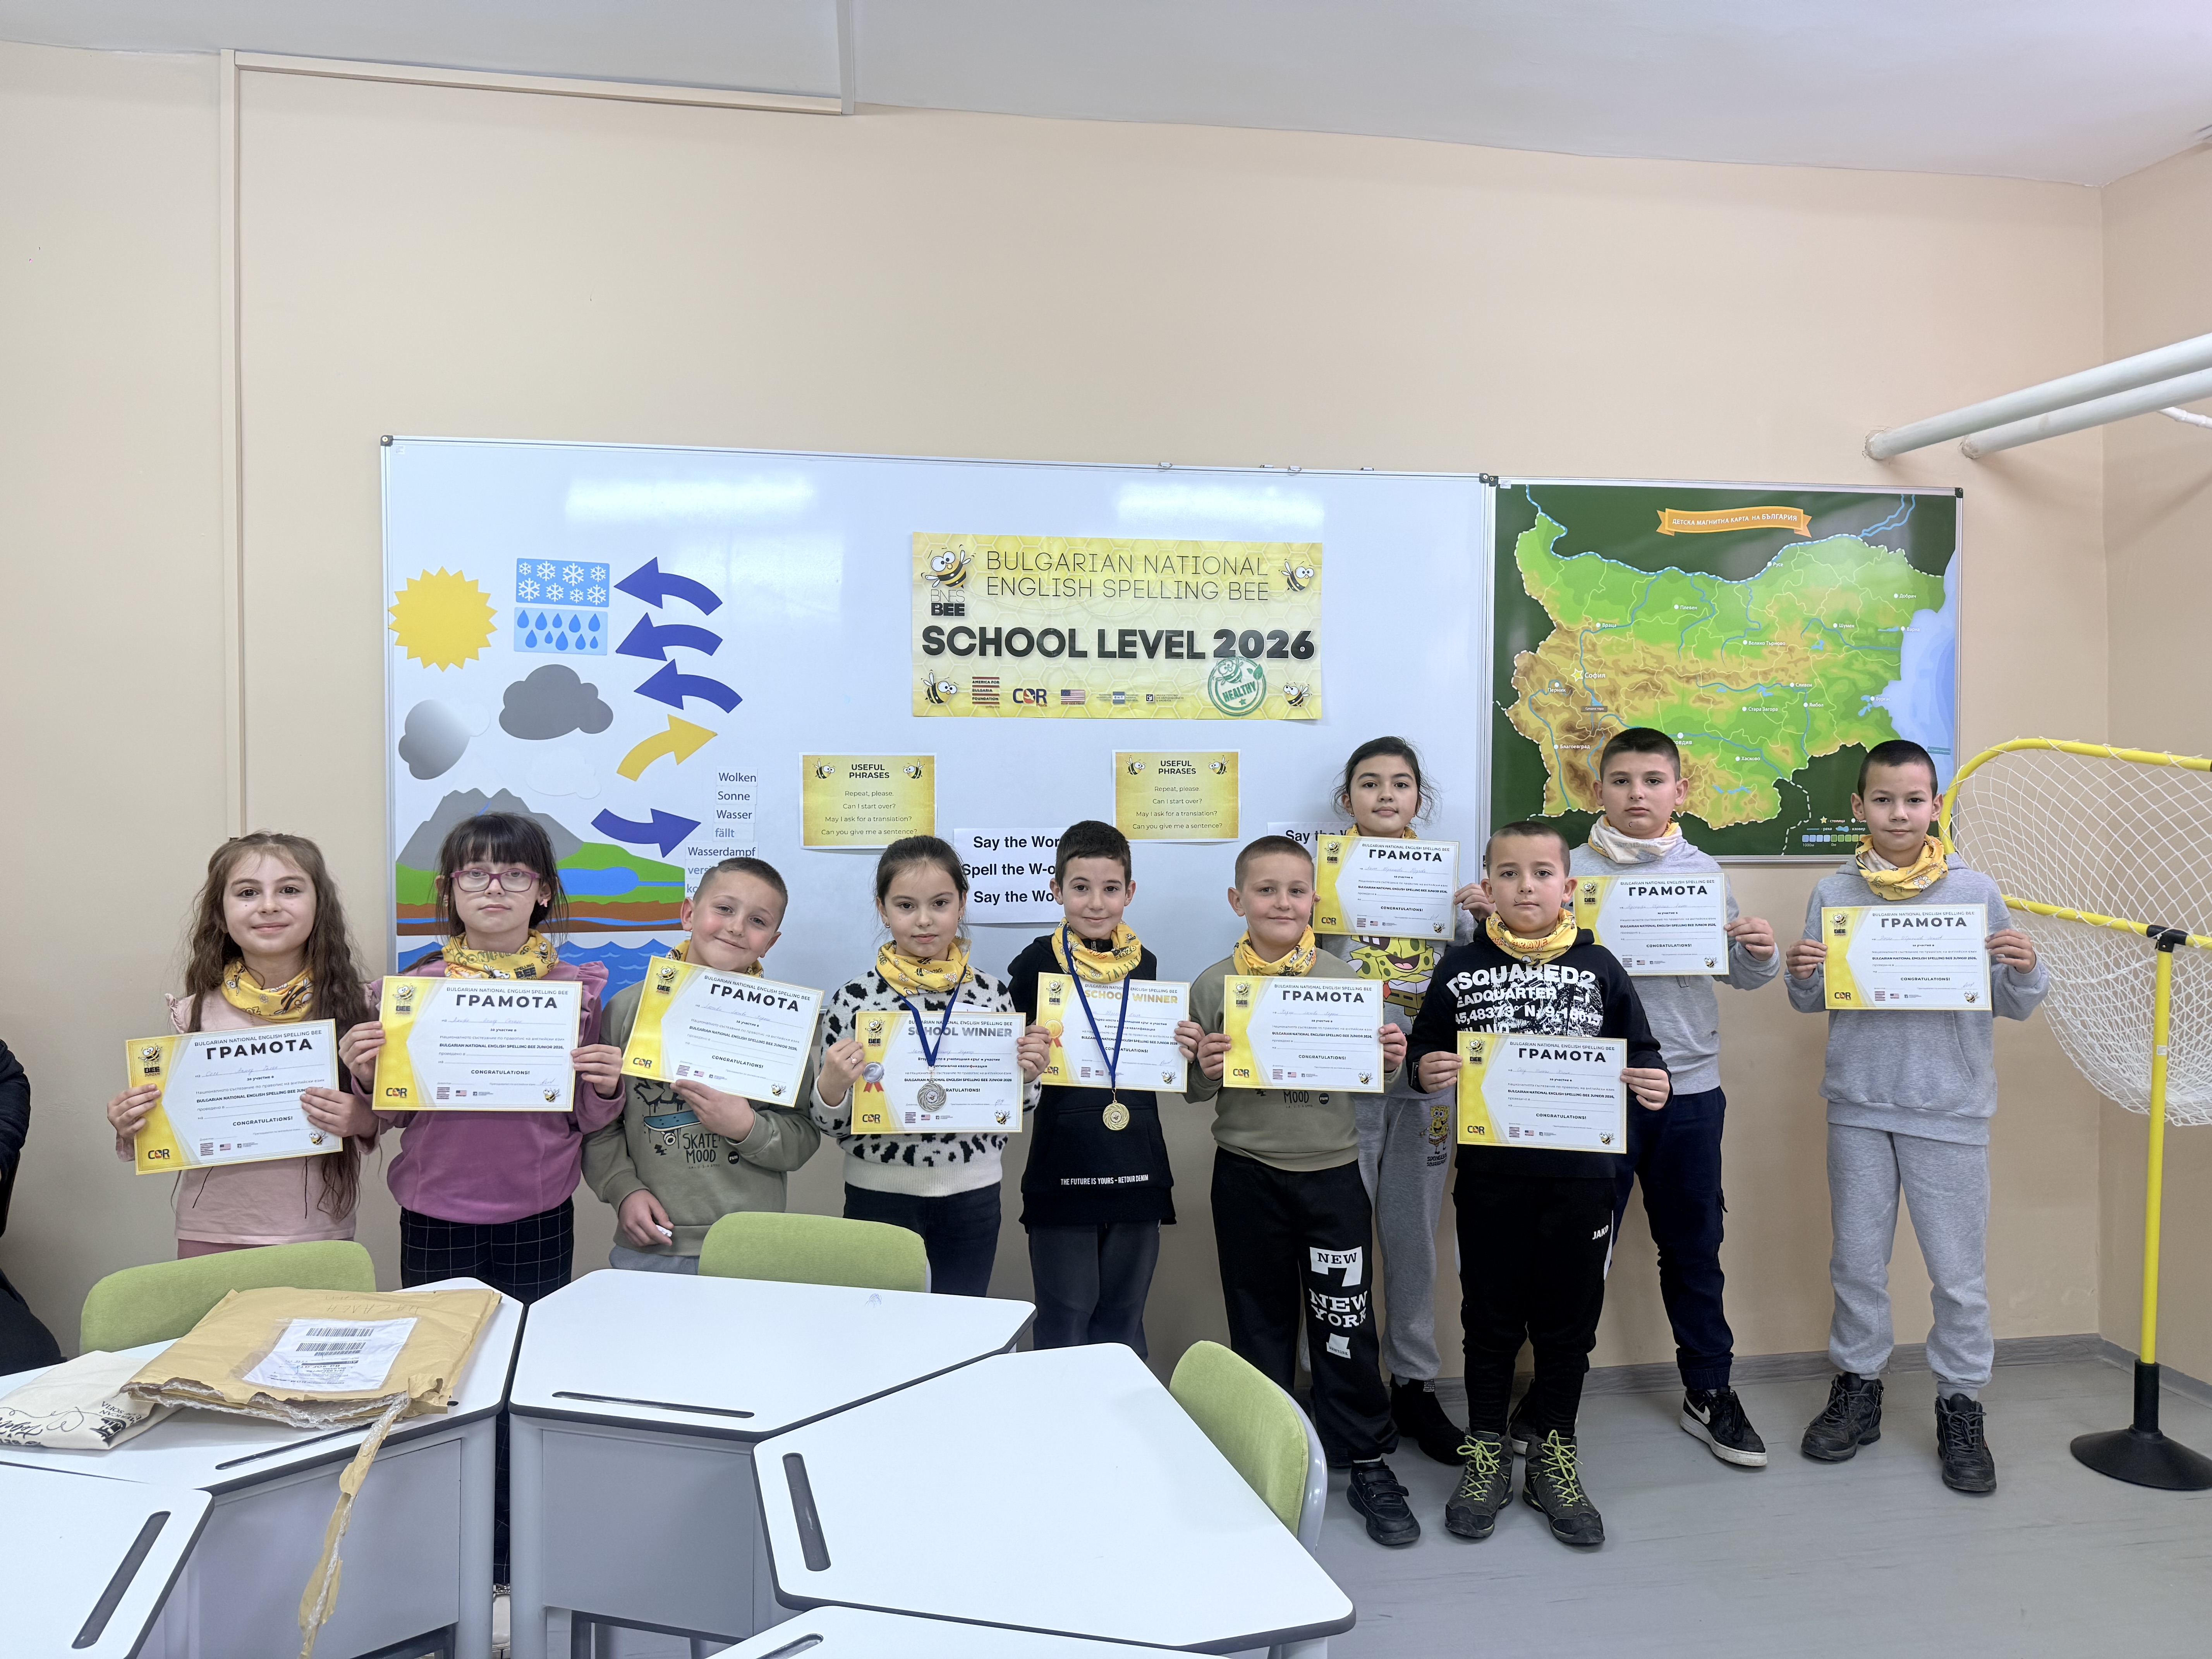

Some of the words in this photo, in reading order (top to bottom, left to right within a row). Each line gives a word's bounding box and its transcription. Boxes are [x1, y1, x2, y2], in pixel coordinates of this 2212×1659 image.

[1762, 513, 1797, 521] БЪЛГАРИЯ
[987, 551, 1132, 573] BULGARIAN
[1144, 554, 1268, 576] NATIONAL
[987, 577, 1092, 597] ENGLISH
[1103, 579, 1218, 599] SPELLING
[1229, 582, 1268, 600] BEE
[931, 589, 965, 603] BNES
[931, 603, 965, 617] BEE
[922, 625, 1088, 658] SCHOOL
[1097, 629, 1206, 659] LEVEL
[1213, 629, 1315, 660] 2026
[1222, 681, 1256, 702] HEALTHY
[719, 773, 756, 782] Wolken
[718, 791, 750, 800] Sonne
[716, 810, 752, 819] Wasser
[715, 828, 735, 837] fällt
[1286, 830, 1310, 844] Say
[974, 836, 1000, 850] Say
[1005, 836, 1027, 848] the
[1031, 836, 1060, 847] Wor
[688, 847, 756, 857] Wasserdampf
[1369, 849, 1442, 862] ГРАМОТА
[962, 864, 997, 878] Spell
[1002, 864, 1024, 875] the
[1029, 863, 1055, 874] W-o
[974, 891, 1000, 905] Say
[1005, 891, 1027, 902] the
[1032, 890, 1054, 902] Wo
[1628, 886, 1707, 896] ГРАМОТА
[1881, 917, 1967, 927] ГРАМОТА
[515, 967, 536, 979] BEE
[456, 994, 558, 1009] ГРАМОТА
[710, 983, 799, 1012] ГРАМОТА
[1084, 989, 1123, 1000] SCHOO
[1132, 993, 1178, 1003] WINNER
[1283, 990, 1364, 1003] ГРАМОТА
[1457, 987, 1557, 1008] EADQUARTER
[962, 1028, 1012, 1037] WINNER
[206, 1038, 313, 1060] ГРАМОТА
[1518, 1048, 1606, 1063] ГРАМОТА
[712, 1055, 763, 1069] CONGRATULATIONS!
[1283, 1091, 1309, 1104] MOOD
[232, 1116, 293, 1127] CONGRATULATIONS!
[682, 1133, 718, 1150] SKATE
[686, 1150, 716, 1164] MOOD
[1592, 1225, 1609, 1240] JAKO
[1317, 1252, 1357, 1264] NEW
[1309, 1288, 1367, 1312] NEW
[1311, 1304, 1366, 1328] YORK
[102, 1401, 124, 1414] SOFIA
